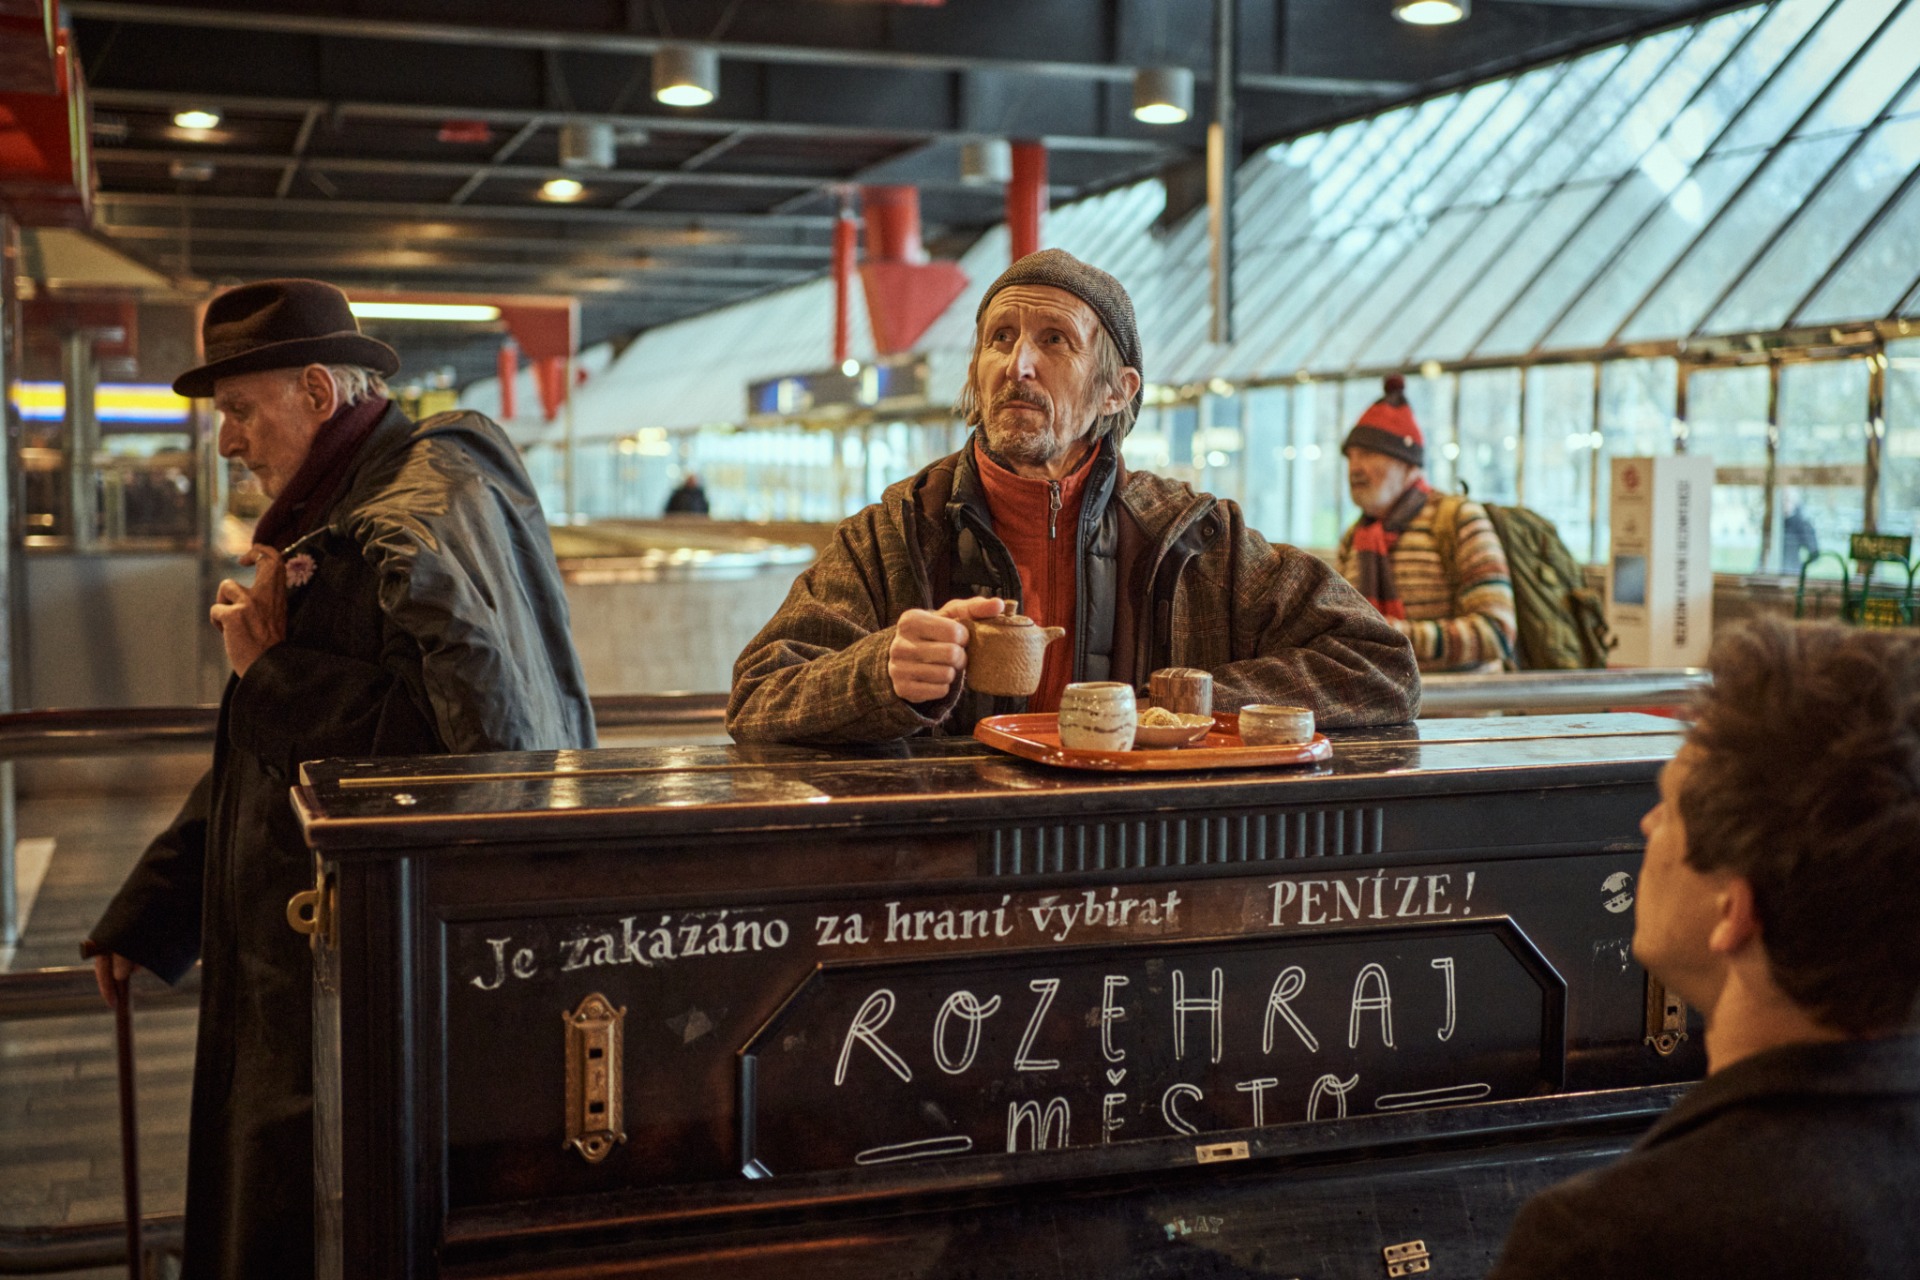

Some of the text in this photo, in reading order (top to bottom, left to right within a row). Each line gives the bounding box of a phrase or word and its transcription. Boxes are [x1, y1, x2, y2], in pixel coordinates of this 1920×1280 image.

[470, 868, 1476, 990] Je zakázáno za hraní vybírat PENÍZE!
[834, 957, 1455, 1086] ROZEHRAJ
